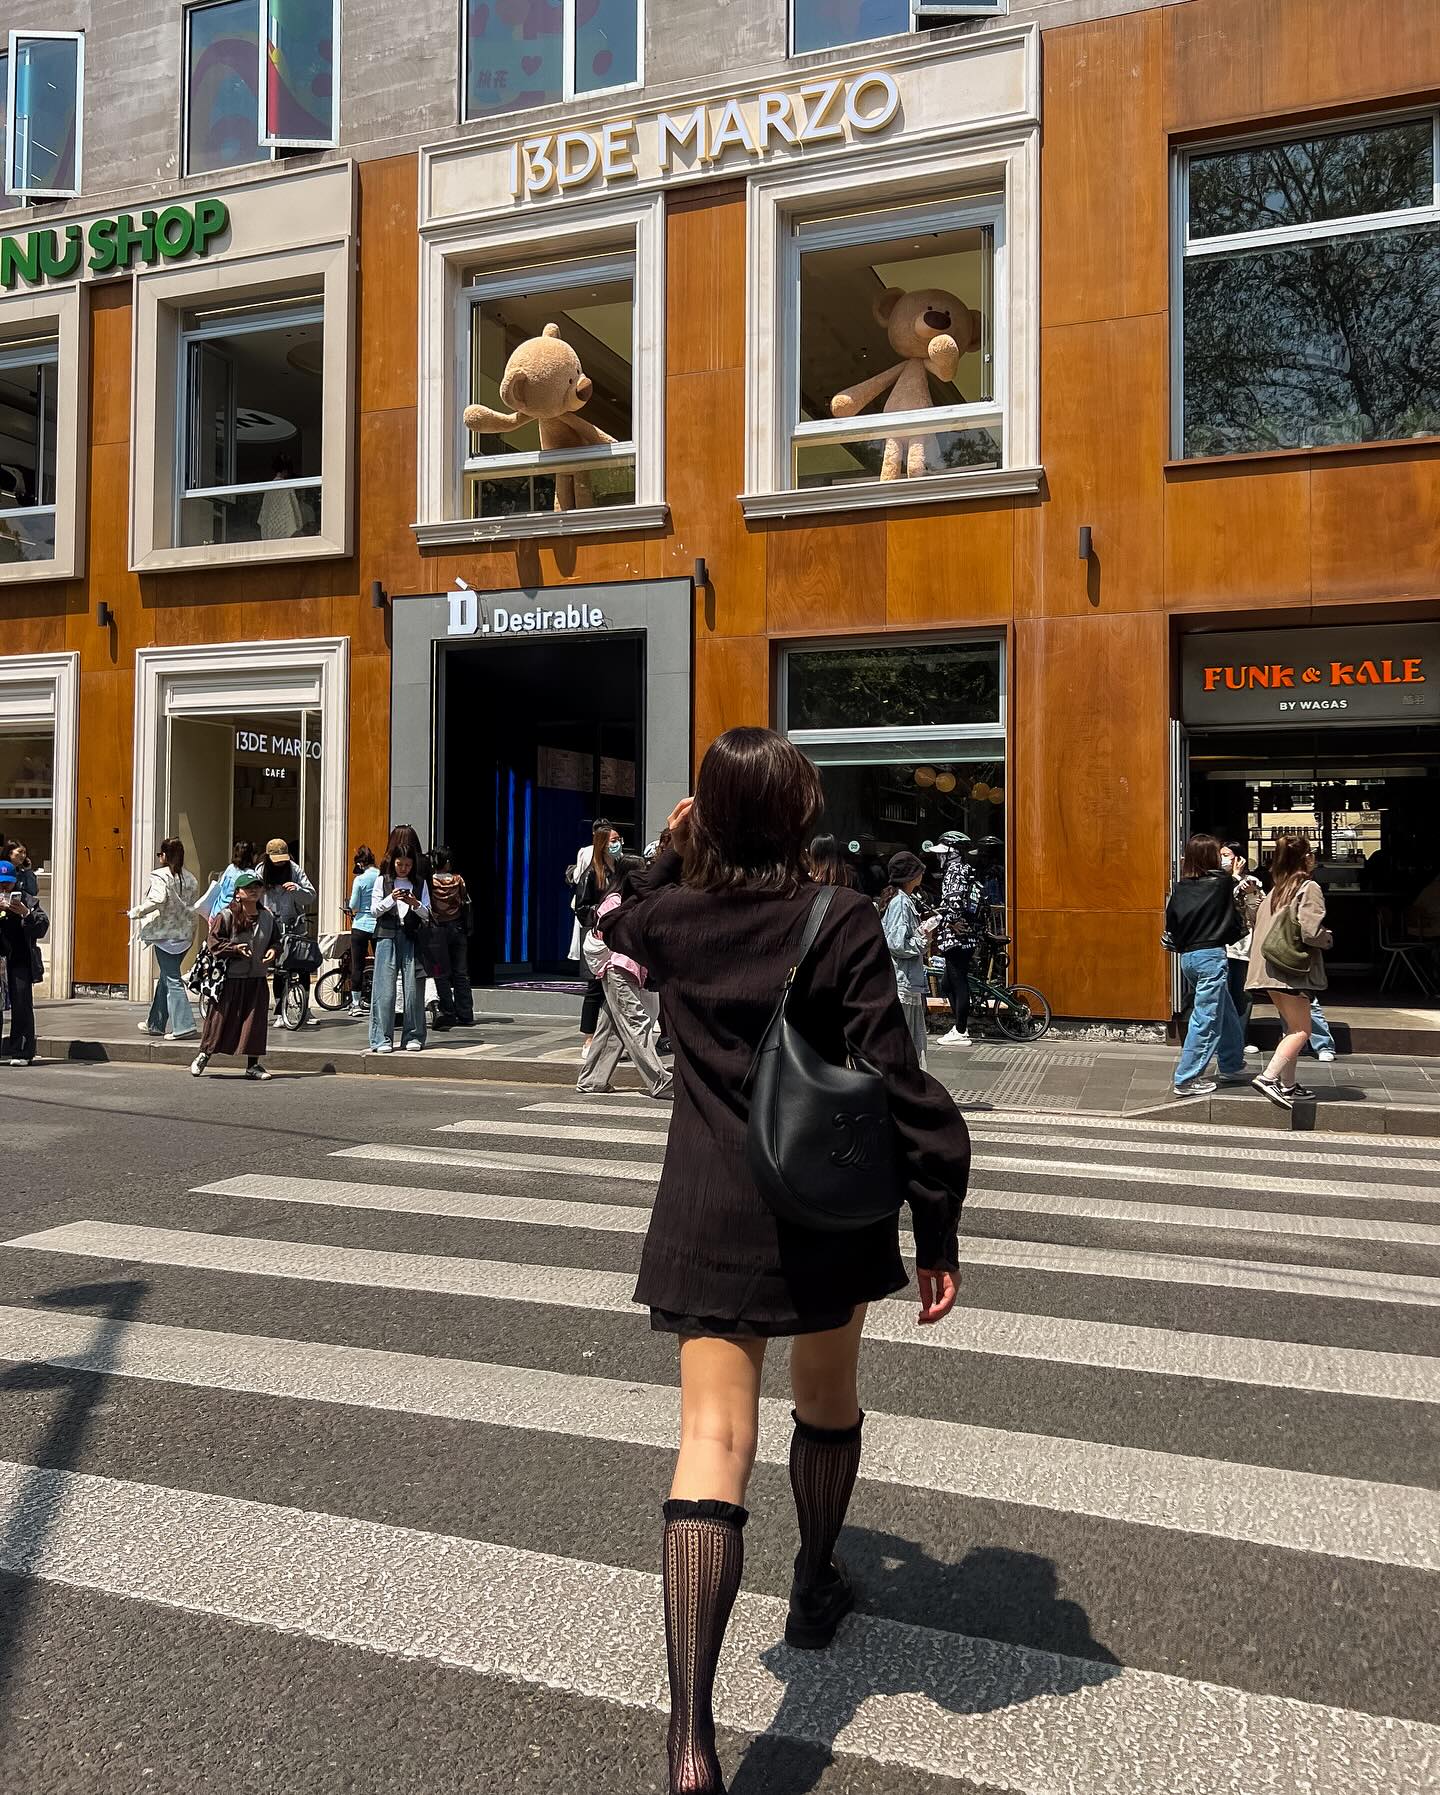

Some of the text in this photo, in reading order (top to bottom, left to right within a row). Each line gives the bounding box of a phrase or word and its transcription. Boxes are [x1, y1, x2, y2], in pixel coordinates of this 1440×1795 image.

[510, 71, 900, 198] 13DE MARZO
[88, 198, 229, 271] SHOP
[493, 603, 604, 633] Desirable
[1203, 658, 1426, 691] FUNK & KALE
[1279, 699, 1348, 711] BY WAGAS
[236, 731, 322, 760] 13DE MARZO
[264, 767, 286, 779] CAFÉ
